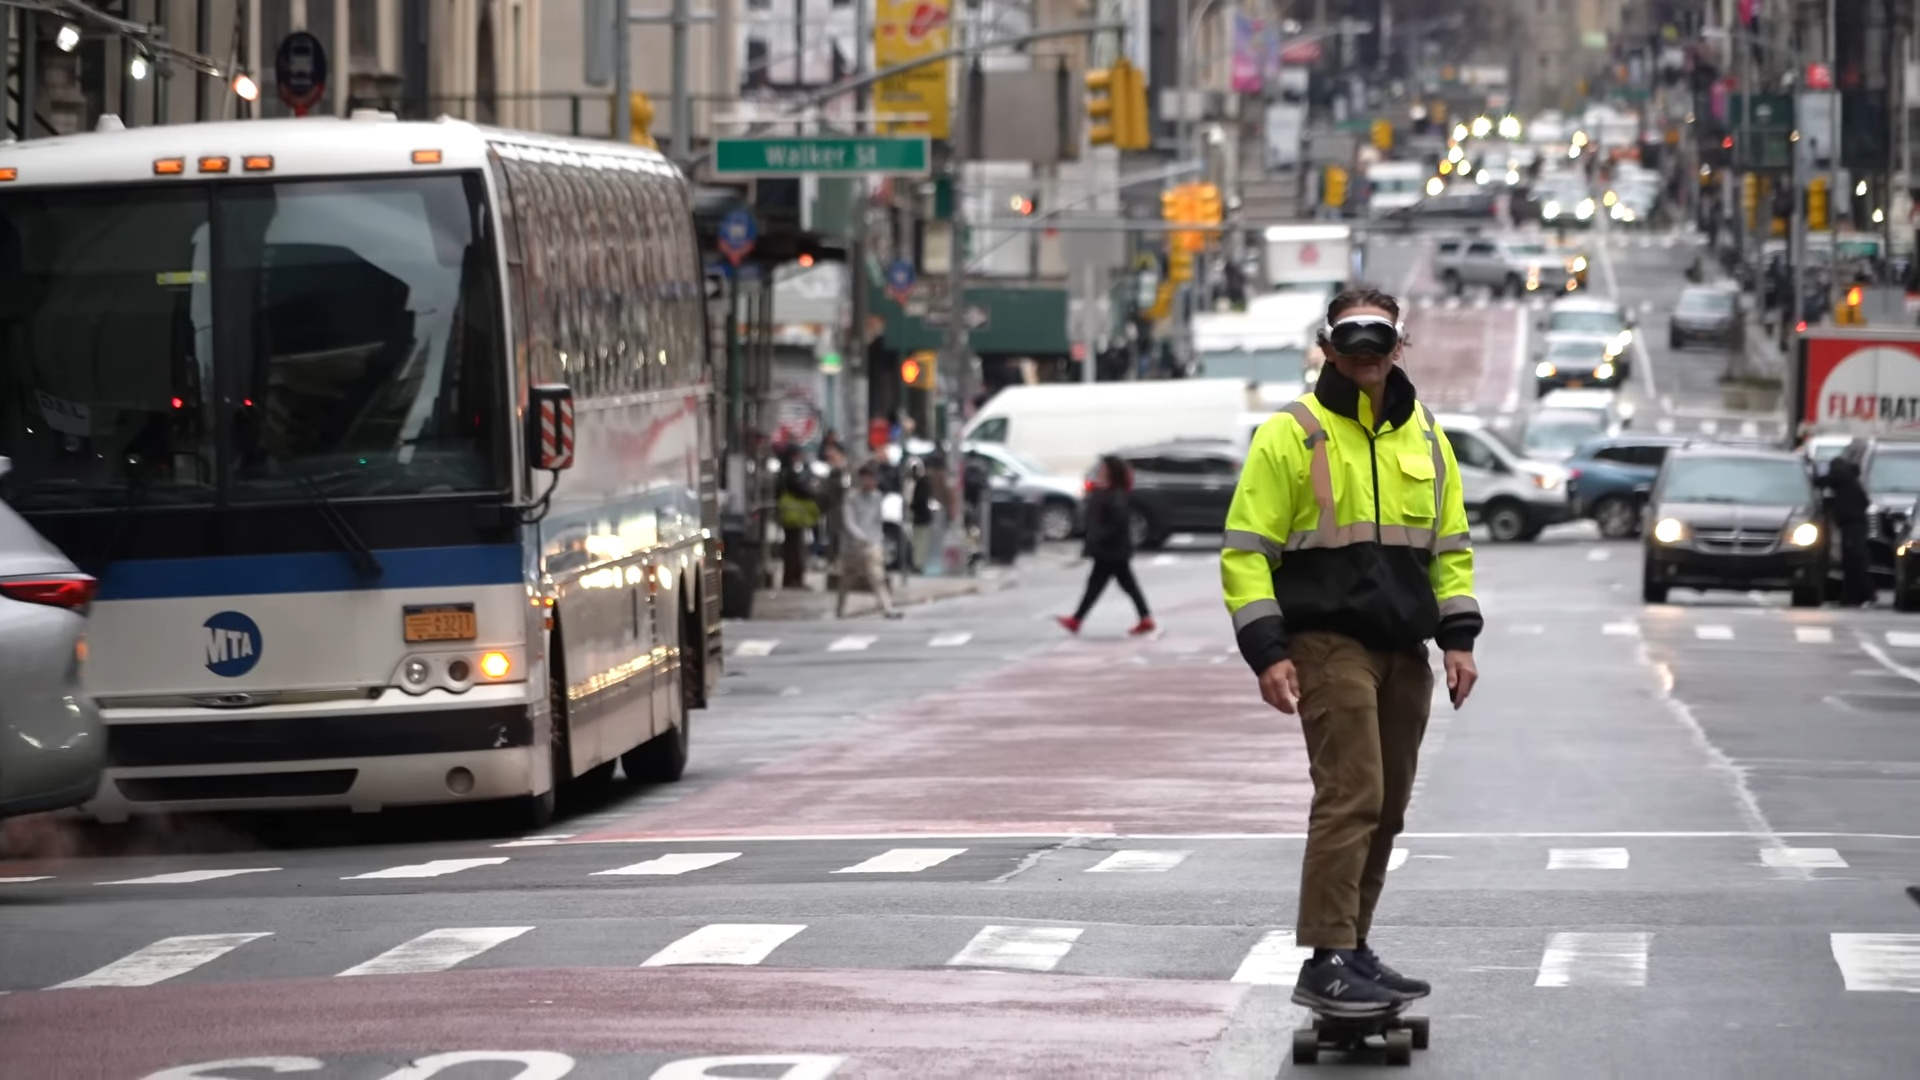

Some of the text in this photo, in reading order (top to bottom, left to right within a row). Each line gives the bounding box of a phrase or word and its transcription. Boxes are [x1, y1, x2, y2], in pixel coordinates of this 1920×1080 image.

[764, 144, 877, 167] Walker St
[203, 626, 253, 664] MTA
